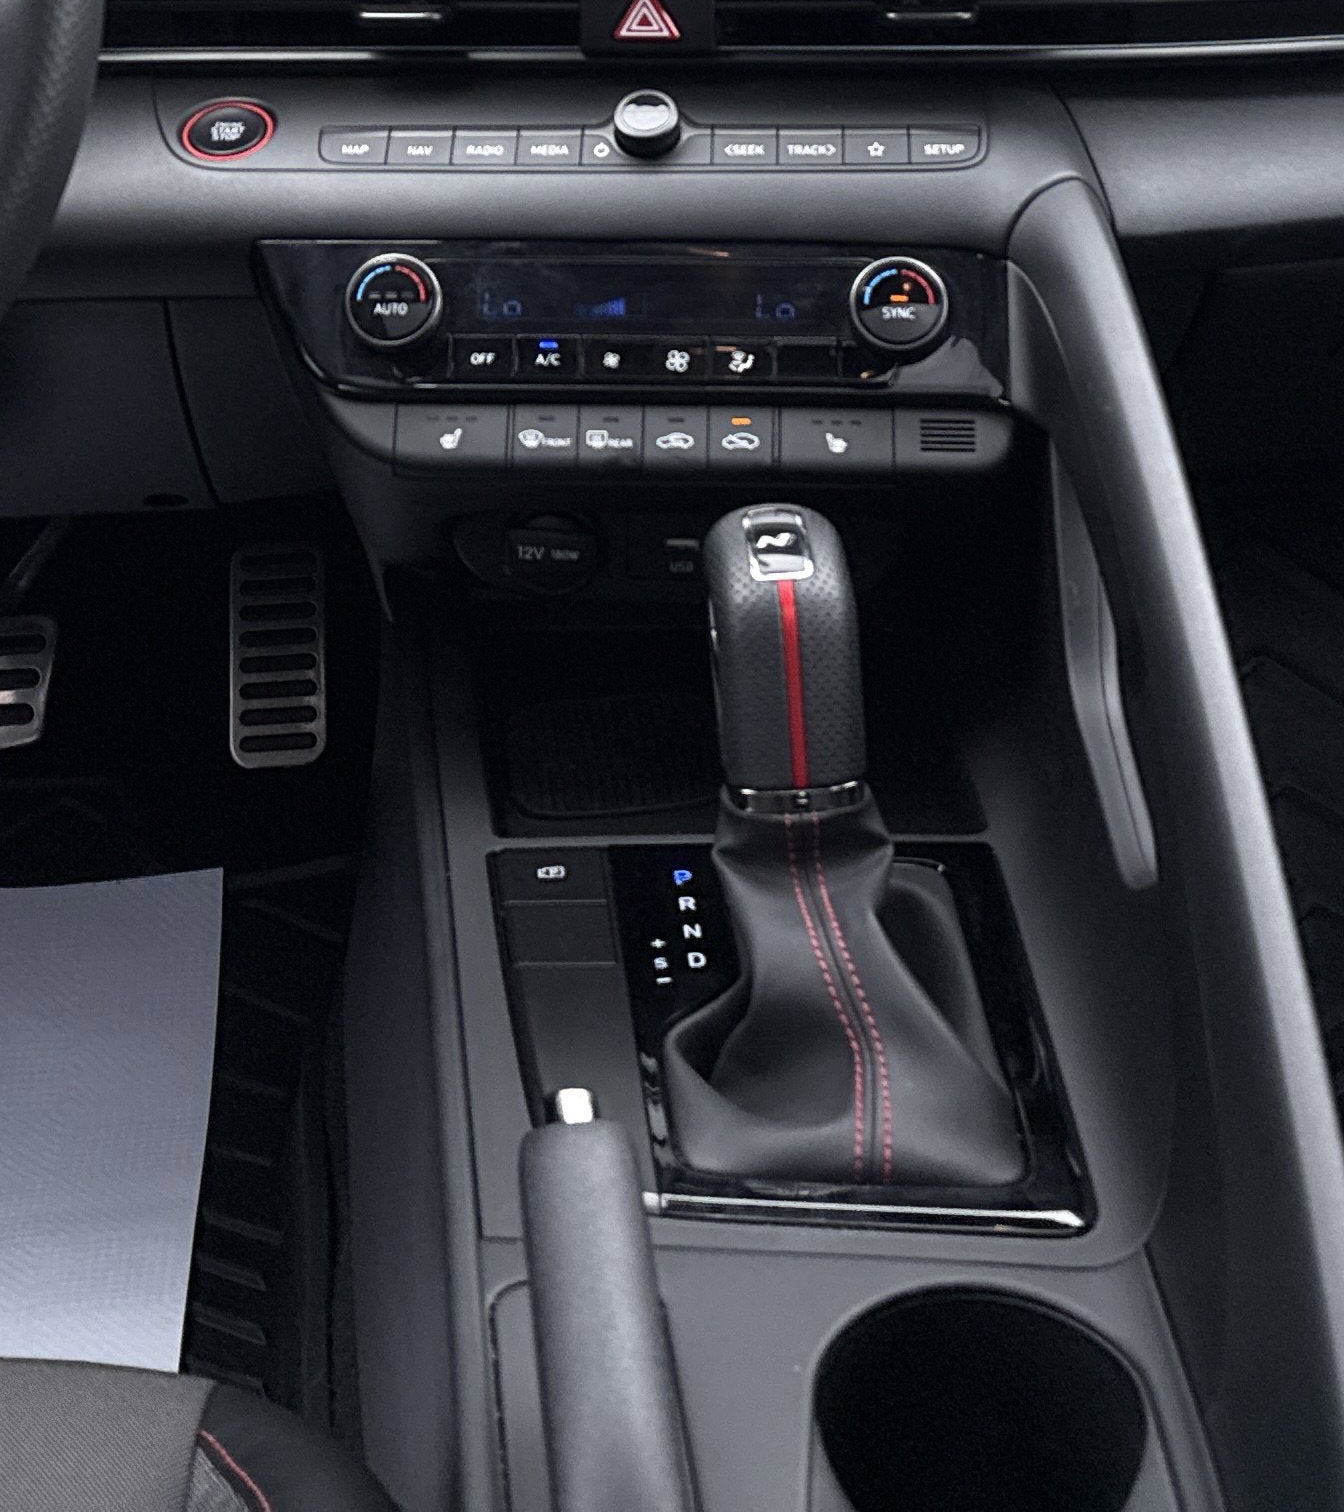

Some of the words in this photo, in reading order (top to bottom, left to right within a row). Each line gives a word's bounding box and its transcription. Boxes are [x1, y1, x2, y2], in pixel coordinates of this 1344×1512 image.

[342, 144, 370, 155] MAP
[407, 144, 433, 156] NAV
[466, 144, 504, 156] RADIO
[530, 144, 569, 156] MEDIA
[924, 143, 965, 155] SETUP
[373, 300, 409, 317] AUTO
[882, 304, 916, 321] SYNC
[470, 352, 496, 366] OFF
[534, 351, 562, 367] A/C
[516, 544, 545, 562] 12V
[668, 560, 695, 575] USB
[673, 869, 693, 886] P
[678, 896, 697, 911] R
[683, 923, 703, 939] N
[653, 957, 670, 970] S
[687, 951, 707, 969] D
